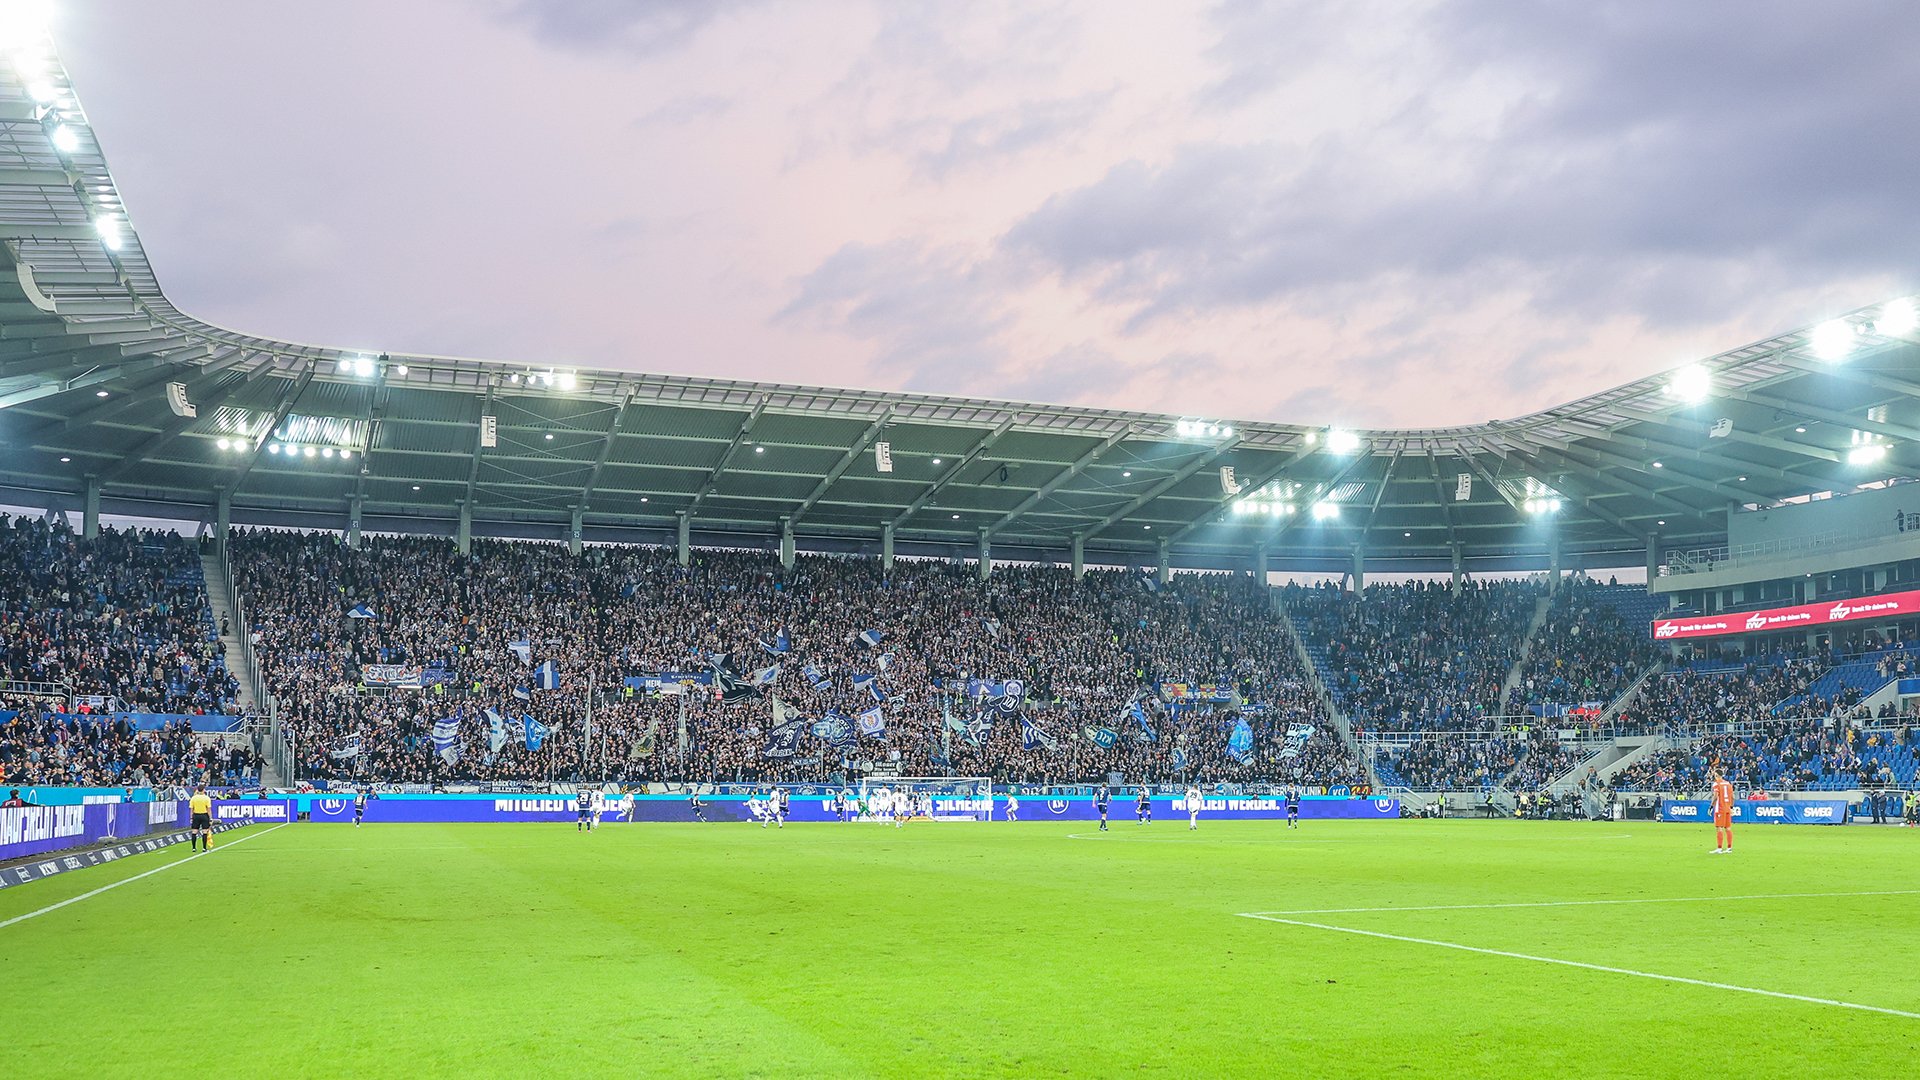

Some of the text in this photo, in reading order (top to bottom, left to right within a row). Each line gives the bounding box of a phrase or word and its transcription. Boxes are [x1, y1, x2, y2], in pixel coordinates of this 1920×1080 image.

[327, 780, 370, 790] Karlsruher
[217, 804, 287, 818] MITGLIED WERDEN.
[1671, 805, 1697, 816] SWEG
[1756, 806, 1784, 817] SWEG
[1803, 806, 1833, 818] SWEG
